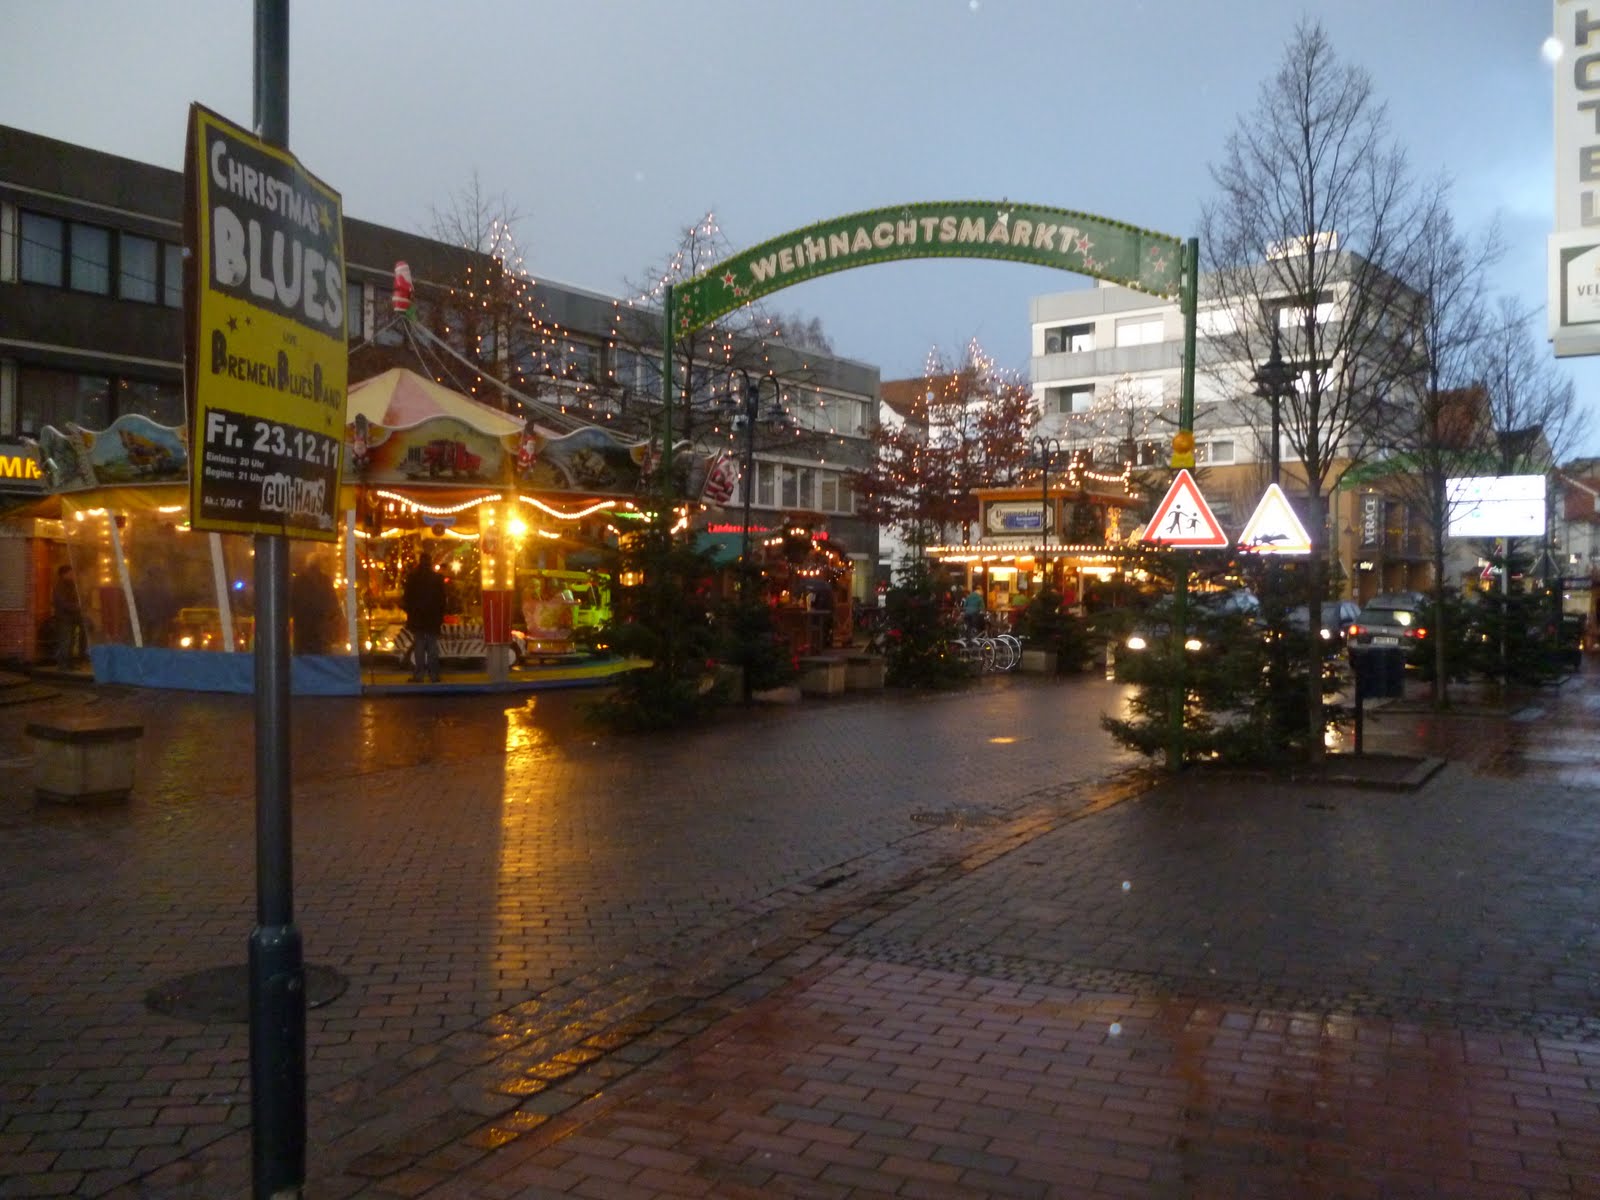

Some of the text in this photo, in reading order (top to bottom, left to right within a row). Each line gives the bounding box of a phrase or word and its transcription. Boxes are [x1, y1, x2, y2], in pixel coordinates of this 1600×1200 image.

[211, 140, 320, 236] CHRISTMAS
[214, 206, 343, 329] BLUES
[748, 215, 1080, 283] WEIHNACHTSMARKT
[206, 452, 265, 470] Einlass: 20 Uhr
[207, 412, 340, 469] Fr. 23.12.11
[205, 466, 265, 483] Beginn: 21 Uhr
[1365, 499, 1376, 545] VERACE
